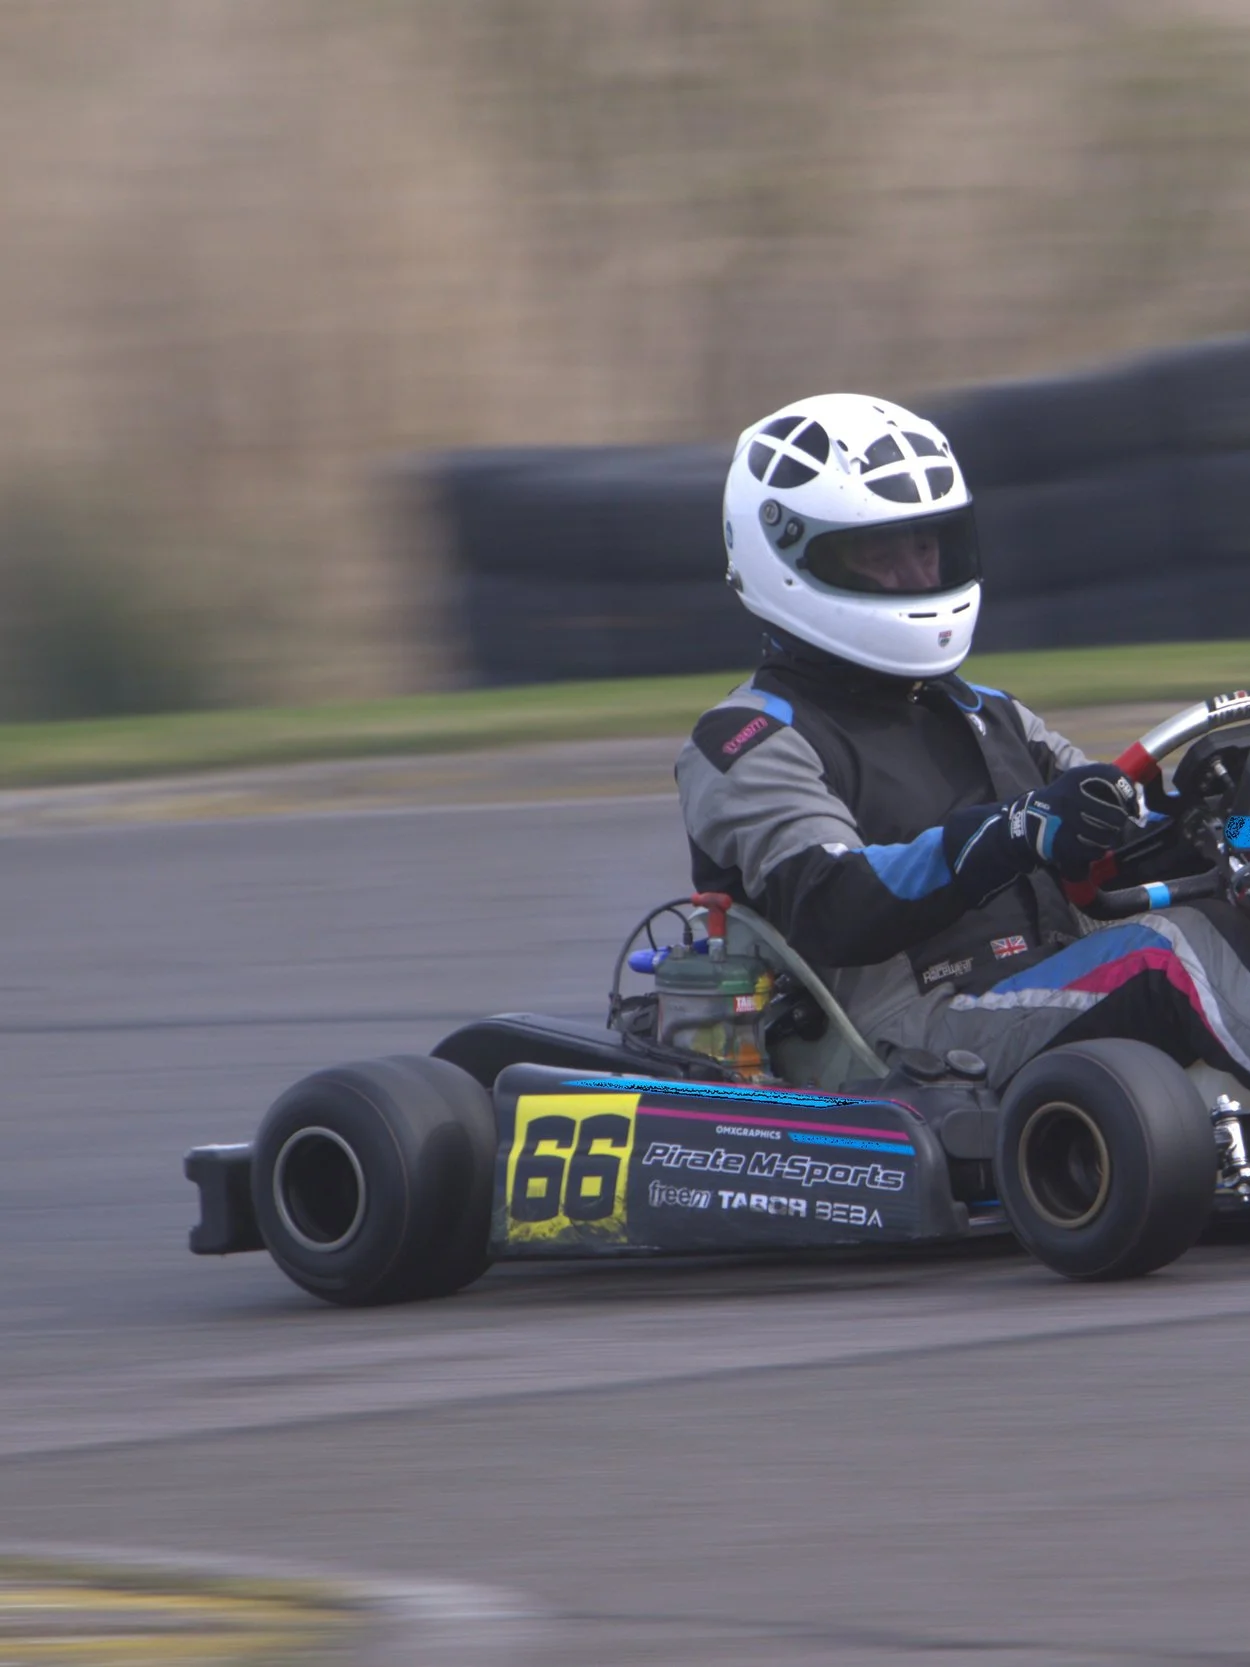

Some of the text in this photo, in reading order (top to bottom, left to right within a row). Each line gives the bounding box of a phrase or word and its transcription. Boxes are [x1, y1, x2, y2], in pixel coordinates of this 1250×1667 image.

[715, 1125, 782, 1140] OMXGRAPHICS
[510, 1113, 632, 1223] 66
[641, 1141, 906, 1192] Pirate M-Sports
[717, 1190, 807, 1218] TABOR
[814, 1200, 884, 1229] BEBA
